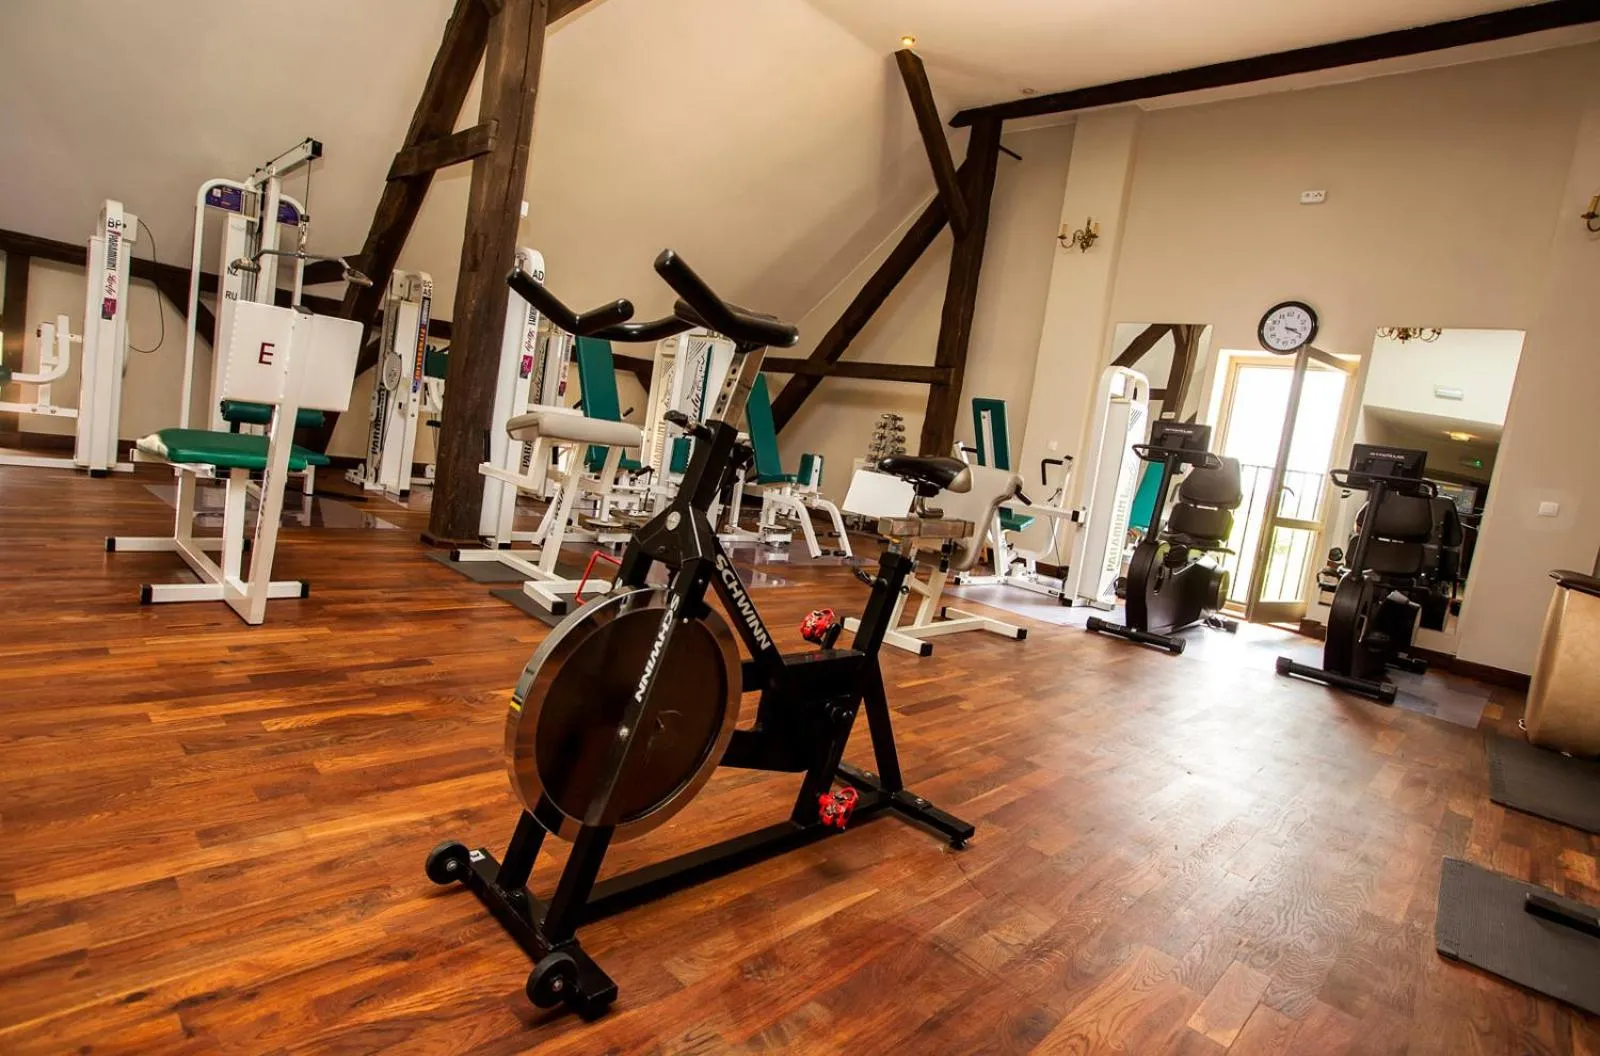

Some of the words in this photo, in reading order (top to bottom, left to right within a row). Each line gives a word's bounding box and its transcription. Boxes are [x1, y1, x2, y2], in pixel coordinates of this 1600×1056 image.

[532, 269, 544, 281] AD
[225, 290, 238, 302] RU
[258, 343, 276, 366] E
[714, 553, 772, 649] SCHWINN
[635, 593, 680, 704] SCHWINN
